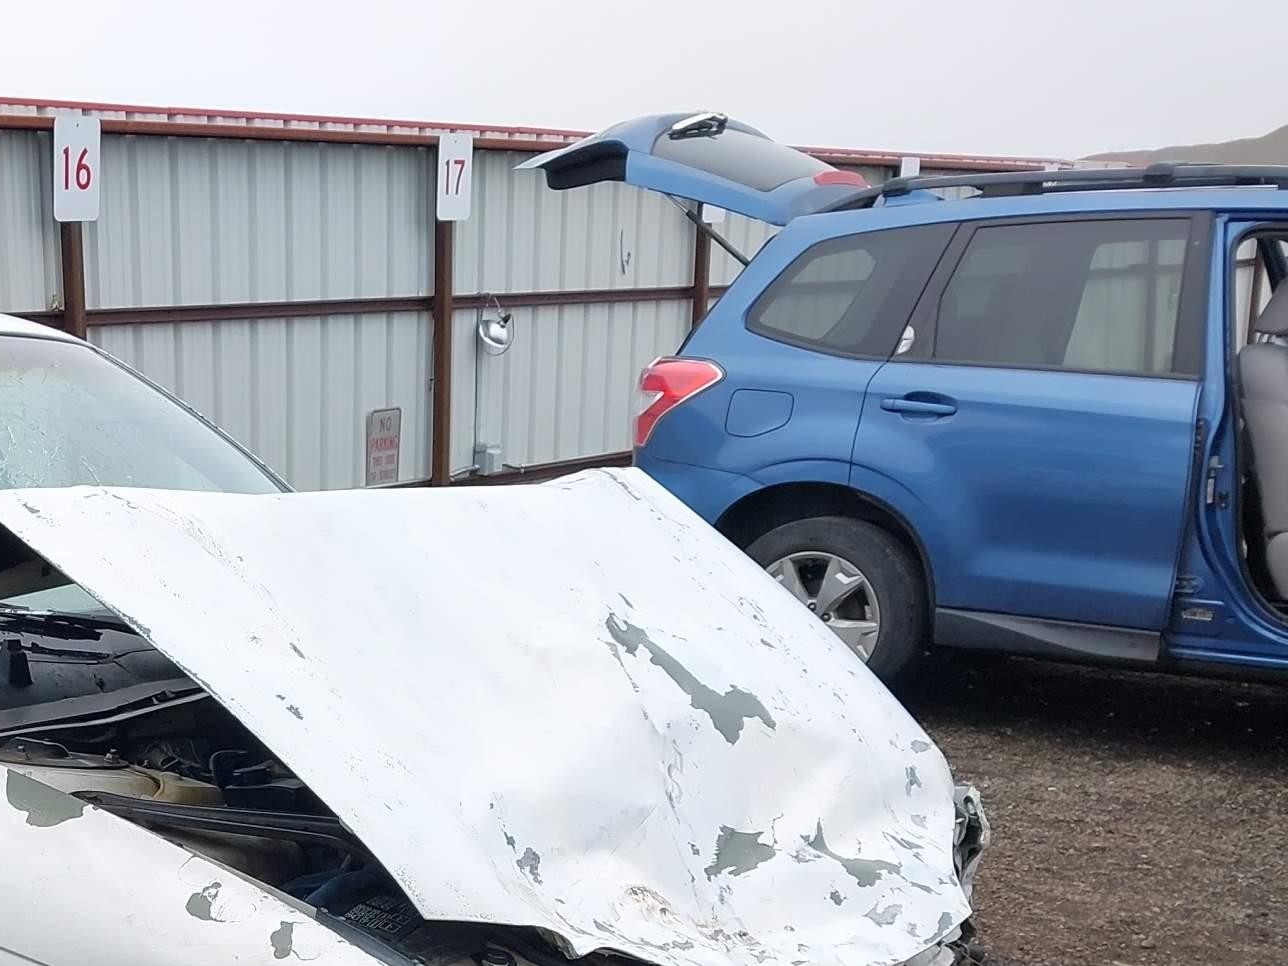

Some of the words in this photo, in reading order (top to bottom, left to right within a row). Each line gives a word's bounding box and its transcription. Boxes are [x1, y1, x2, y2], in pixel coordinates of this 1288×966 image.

[63, 146, 91, 191] 16
[445, 159, 466, 196] 17
[380, 415, 392, 433] NO
